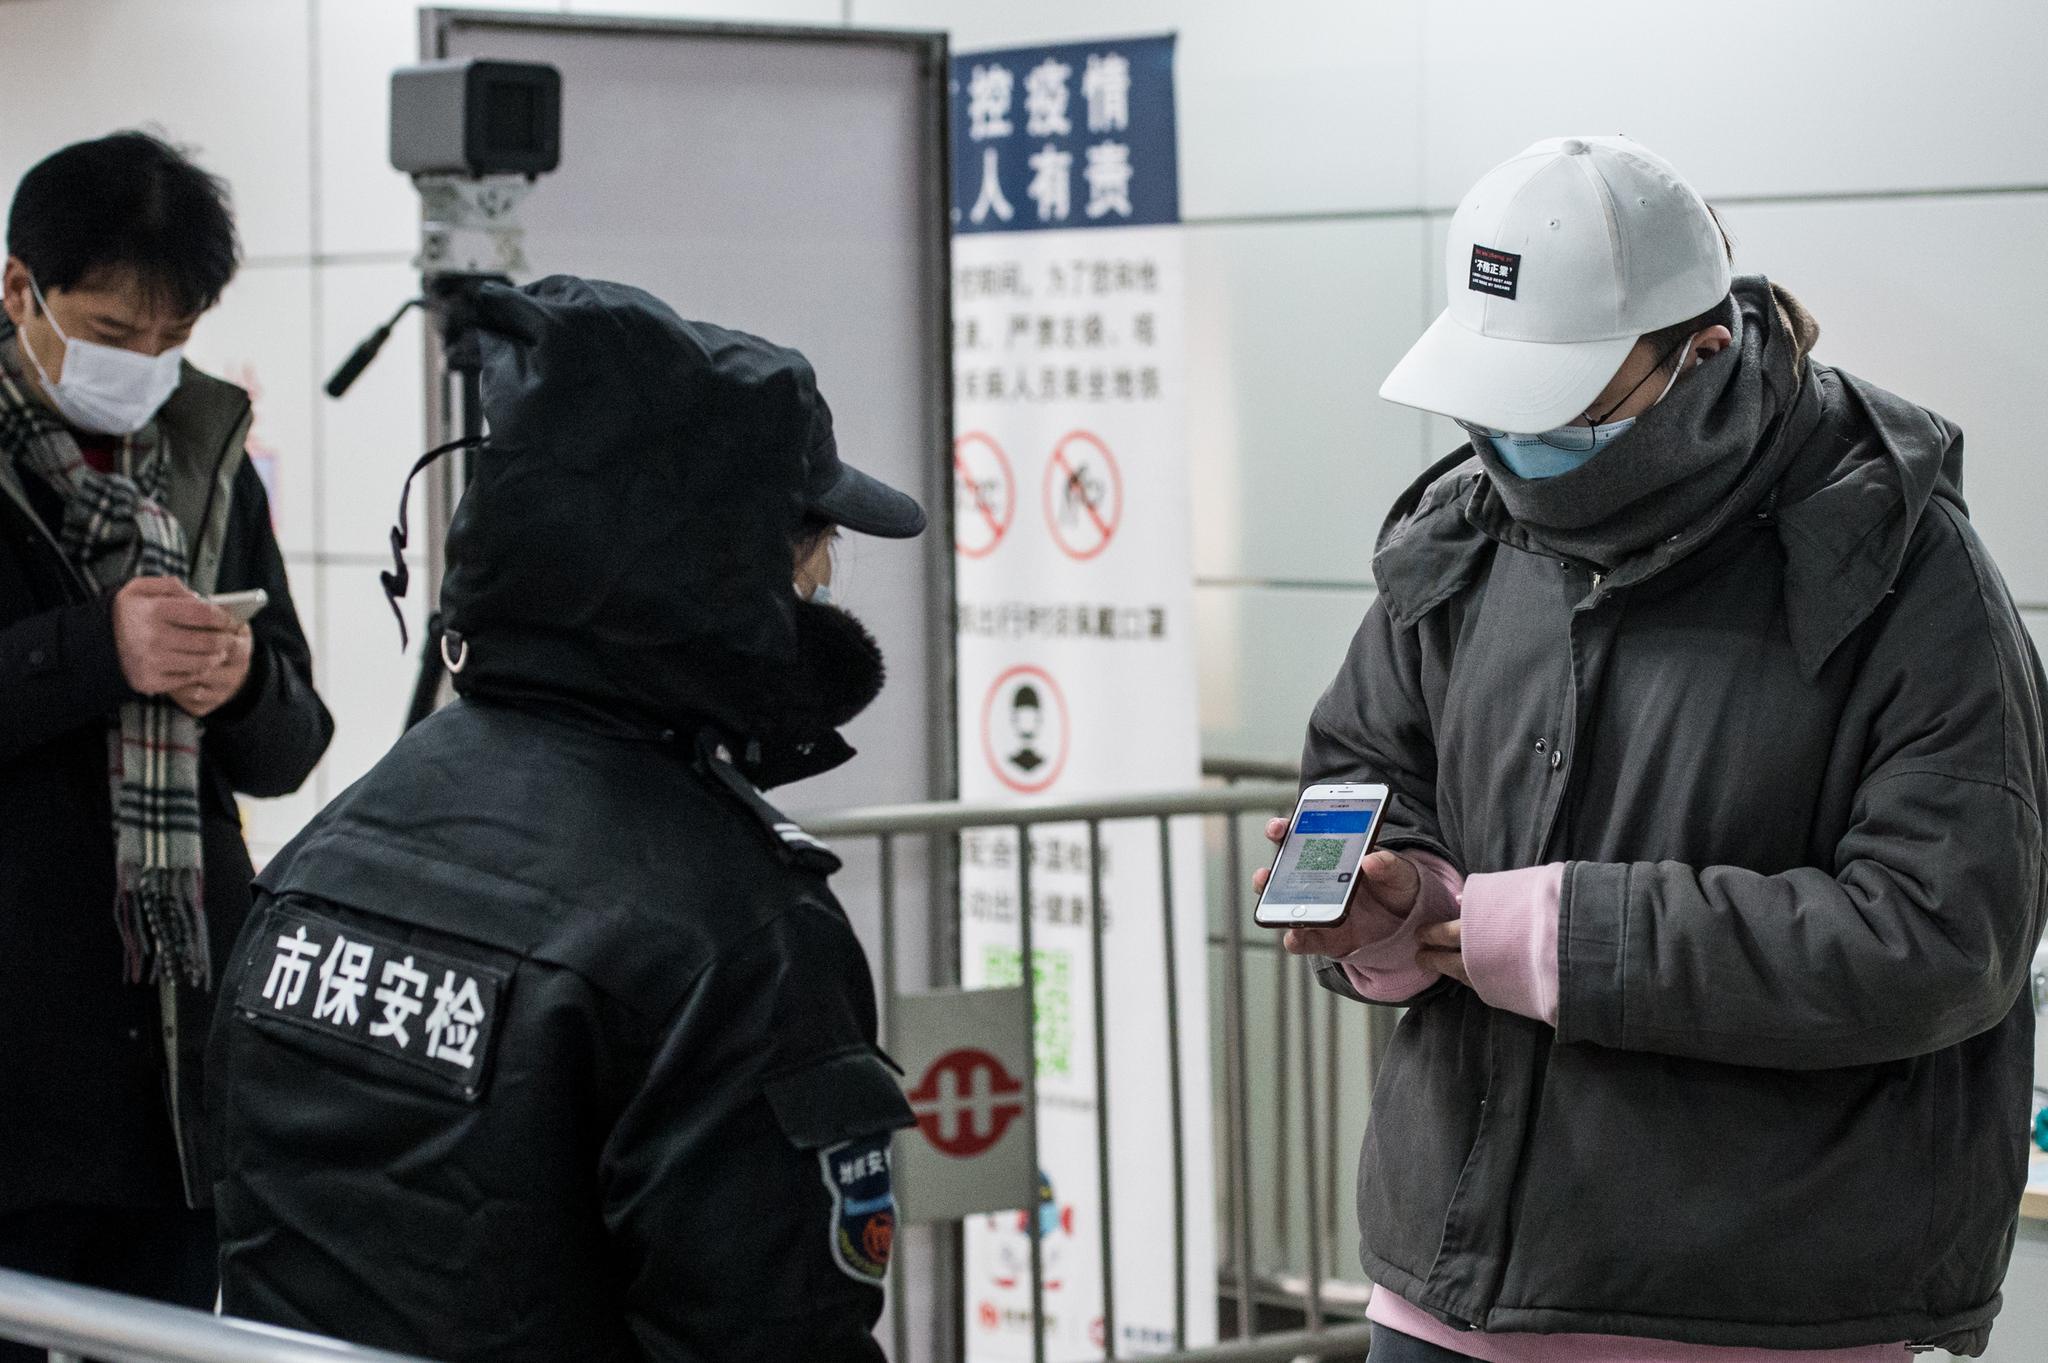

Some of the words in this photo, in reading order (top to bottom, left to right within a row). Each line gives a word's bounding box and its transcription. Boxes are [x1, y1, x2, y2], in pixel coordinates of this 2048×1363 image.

[952, 51, 1131, 141] 控疫情
[952, 139, 1134, 224] 人有责
[262, 925, 485, 1069] 市保安检
